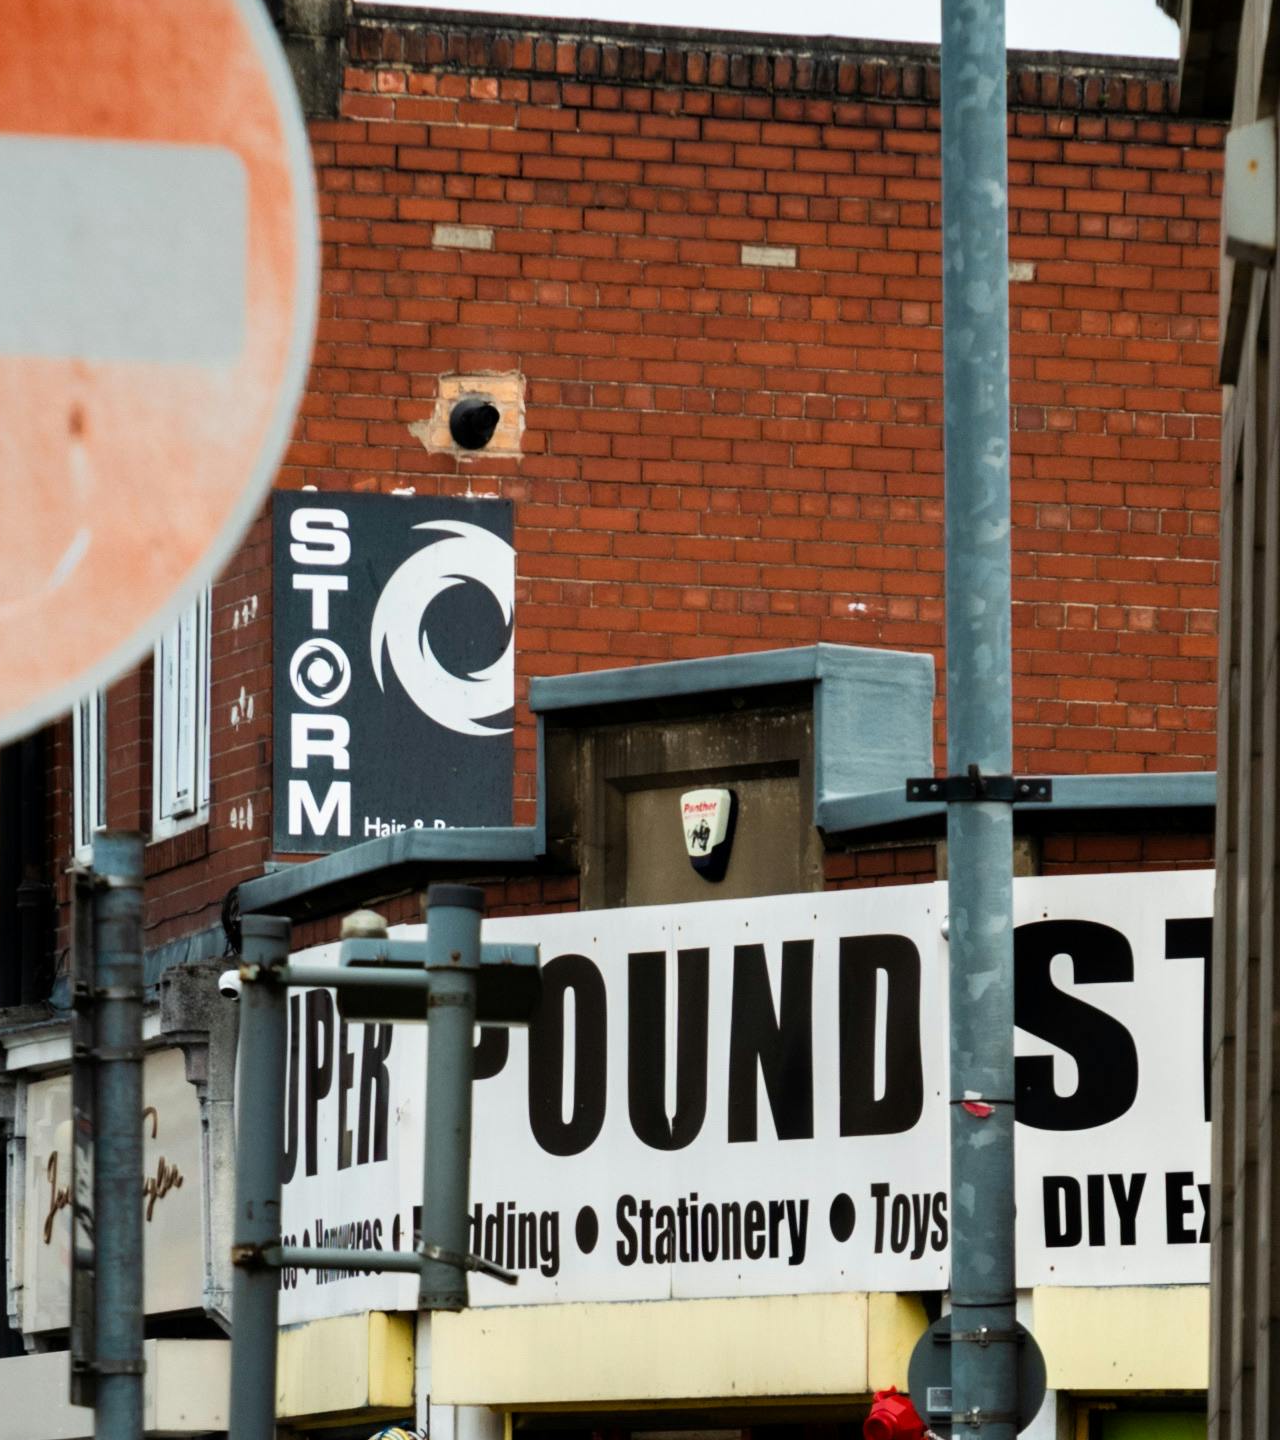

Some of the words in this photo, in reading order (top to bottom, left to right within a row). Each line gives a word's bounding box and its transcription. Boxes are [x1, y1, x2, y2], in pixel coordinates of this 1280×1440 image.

[288, 507, 351, 837] STORM
[280, 988, 393, 1185] UPER
[616, 1190, 809, 1266] Stationery
[870, 1182, 948, 1260] Toys
[1043, 1173, 1147, 1248] DIY
